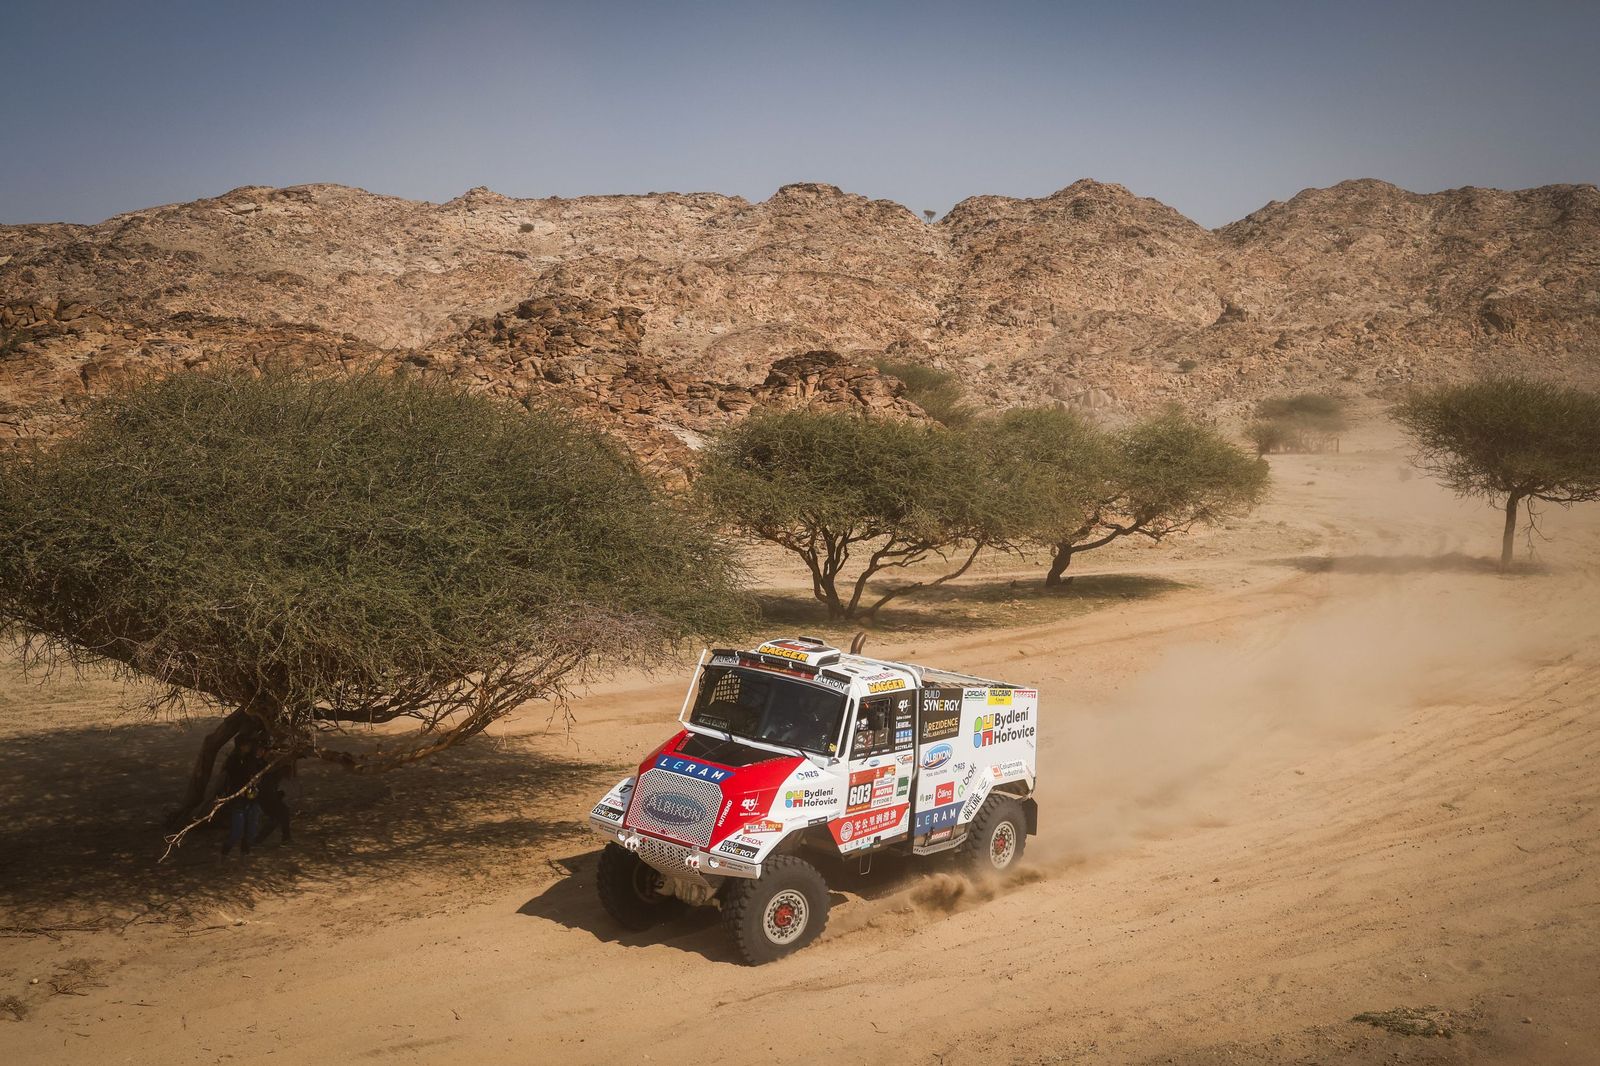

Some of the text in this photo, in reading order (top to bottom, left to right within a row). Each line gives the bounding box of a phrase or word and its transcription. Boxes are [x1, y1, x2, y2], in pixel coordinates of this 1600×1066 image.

[816, 674, 846, 691] ALTRON
[924, 690, 941, 699] BUILD
[923, 700, 961, 712] SYNERGY
[928, 717, 959, 731] REZIDENCE
[994, 708, 1029, 729] Bydlení
[994, 726, 1035, 744] Hořovice
[659, 757, 726, 781] LERAM
[804, 787, 834, 800] Bydlení
[849, 784, 871, 806] 603
[803, 797, 838, 808] Hořovice
[964, 793, 982, 820] ON-LINE
[594, 808, 620, 821] SYNERGY
[718, 800, 732, 827] NUTREND
[916, 808, 956, 828] LERAM
[741, 836, 763, 846] ESOX
[720, 846, 755, 858] SYNERGY
